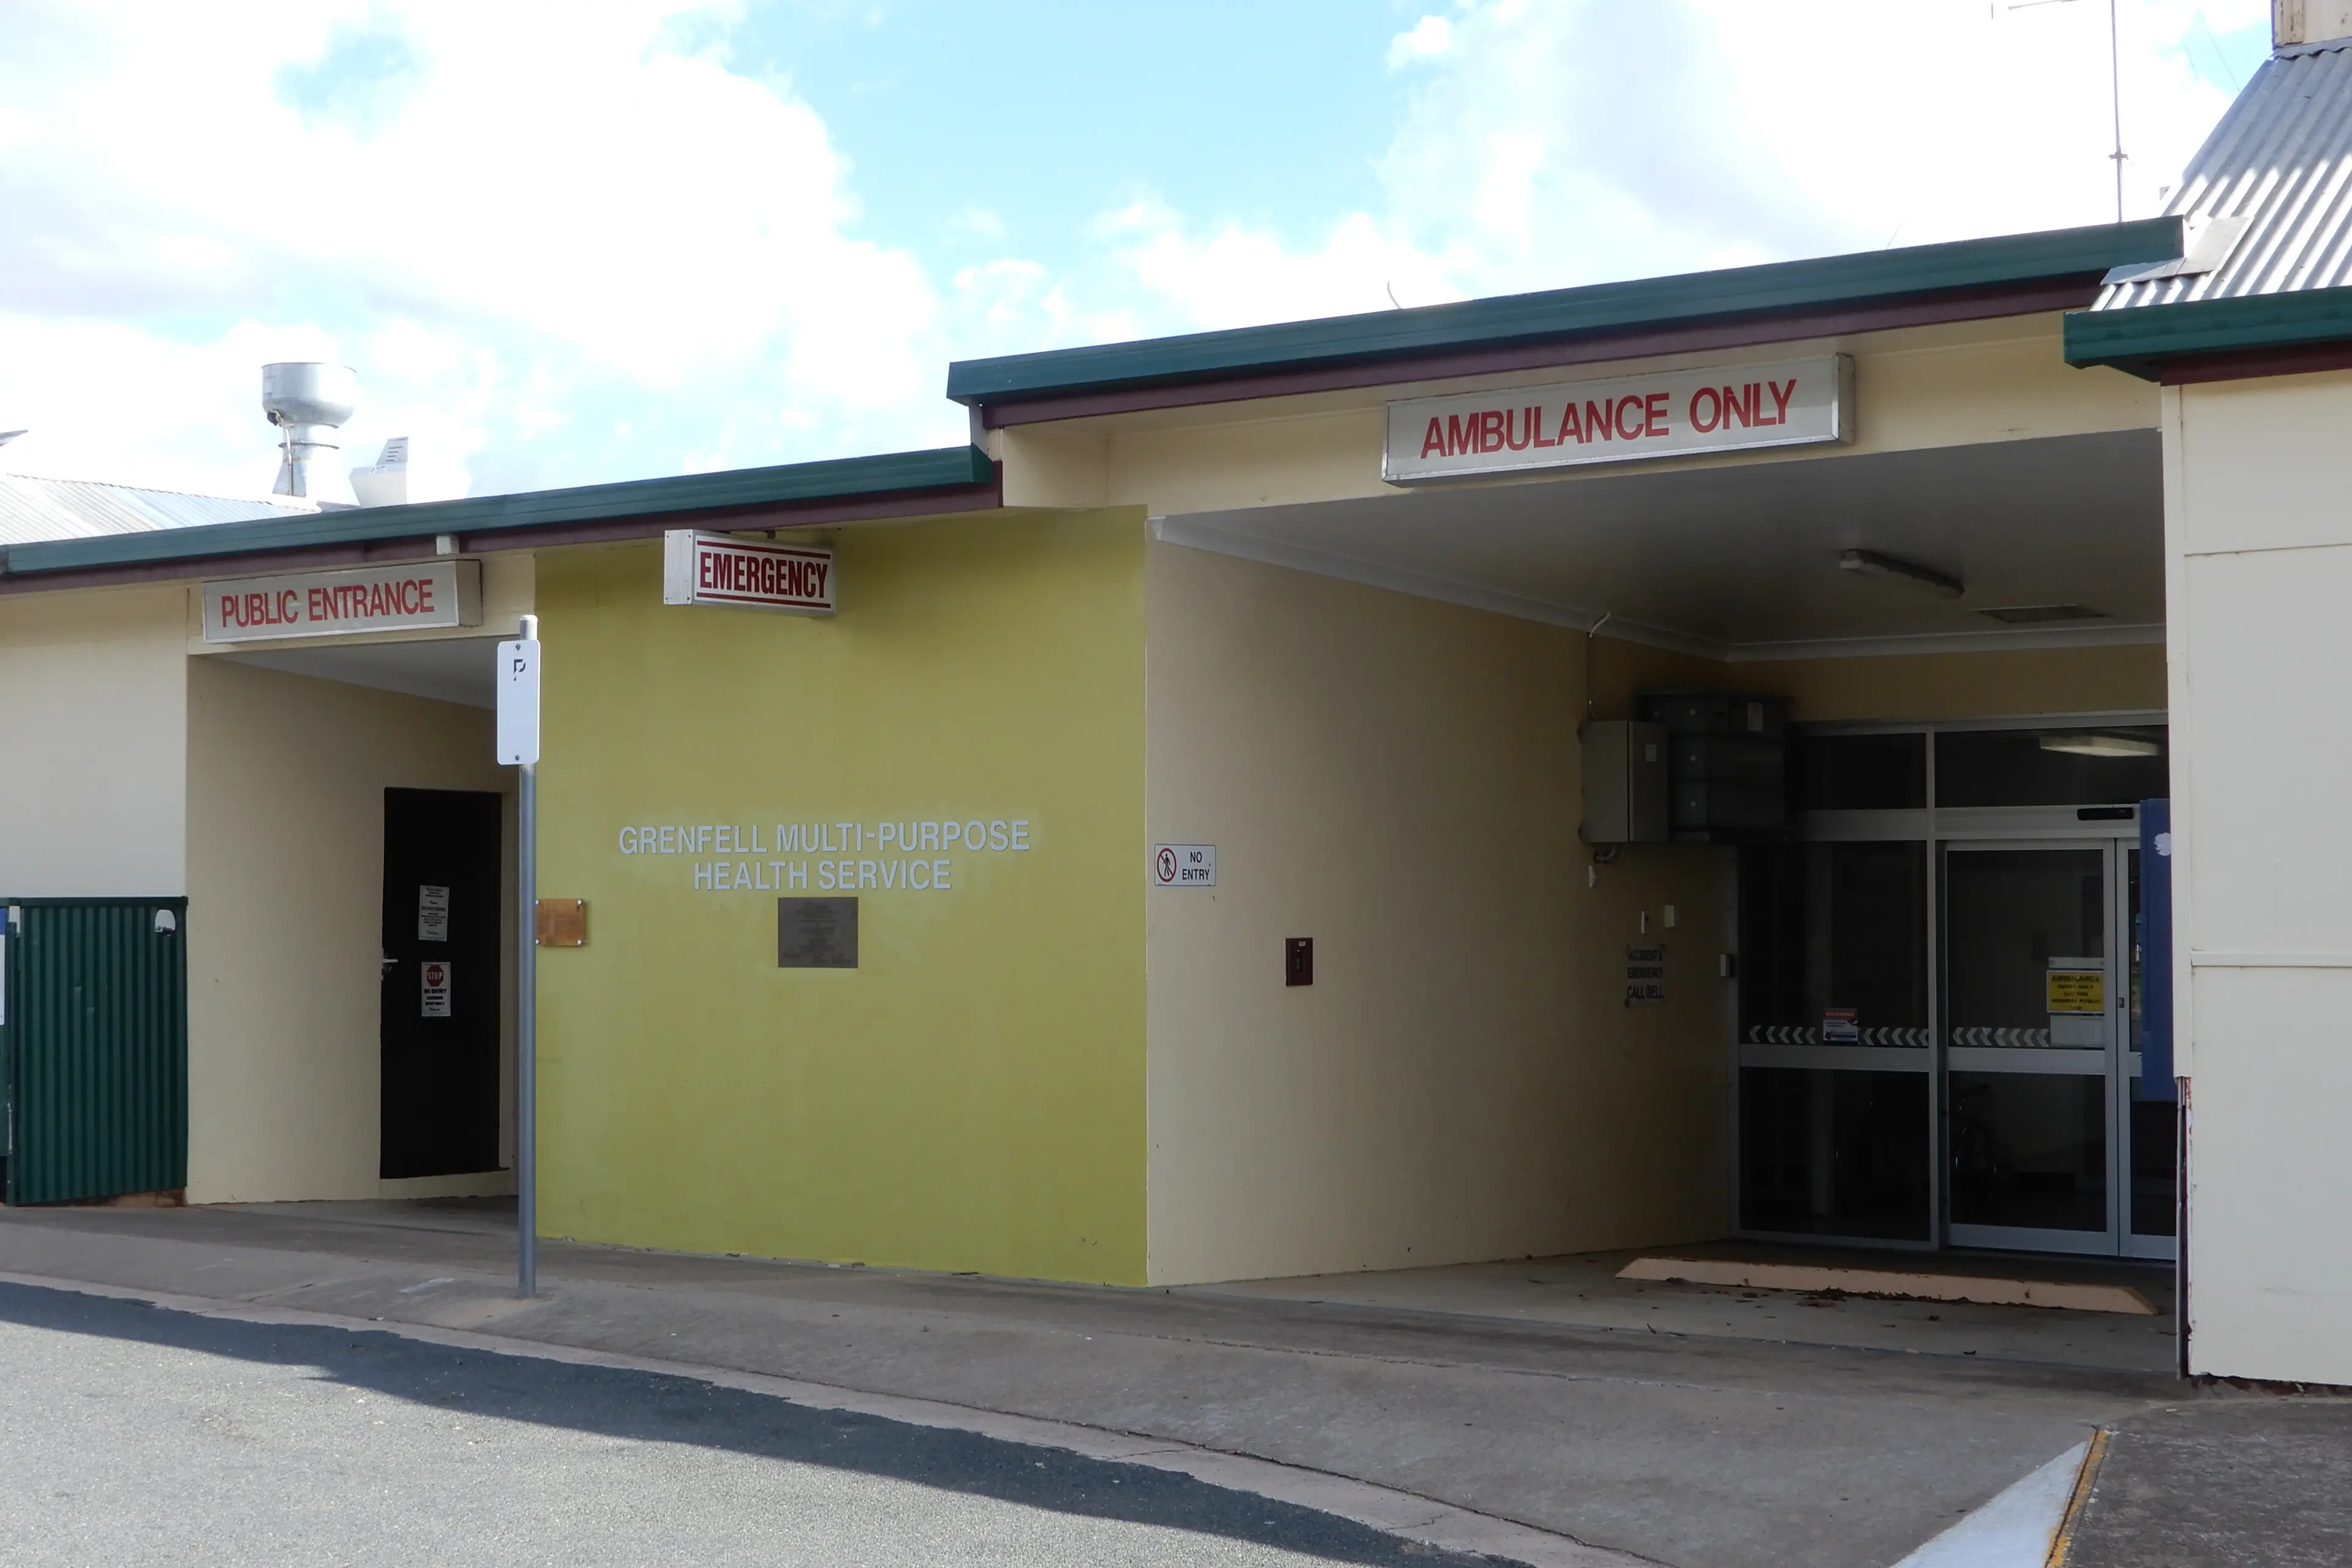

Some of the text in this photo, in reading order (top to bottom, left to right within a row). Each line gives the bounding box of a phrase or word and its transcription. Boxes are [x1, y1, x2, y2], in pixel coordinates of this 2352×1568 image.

[1420, 379, 1798, 459] AMBULANCE ONLY
[699, 551, 828, 598] EMERGENCY
[221, 579, 435, 628] PUBLIC ENTRANCE
[619, 820, 1031, 854] GRENFELL MULTI-PURPOSE
[1189, 851, 1202, 863] NO
[693, 859, 952, 891] HEALTH SERVICE
[1182, 869, 1210, 881] ENTRY
[428, 971, 443, 980] STOP
[1627, 985, 1664, 999] CALL BELL
